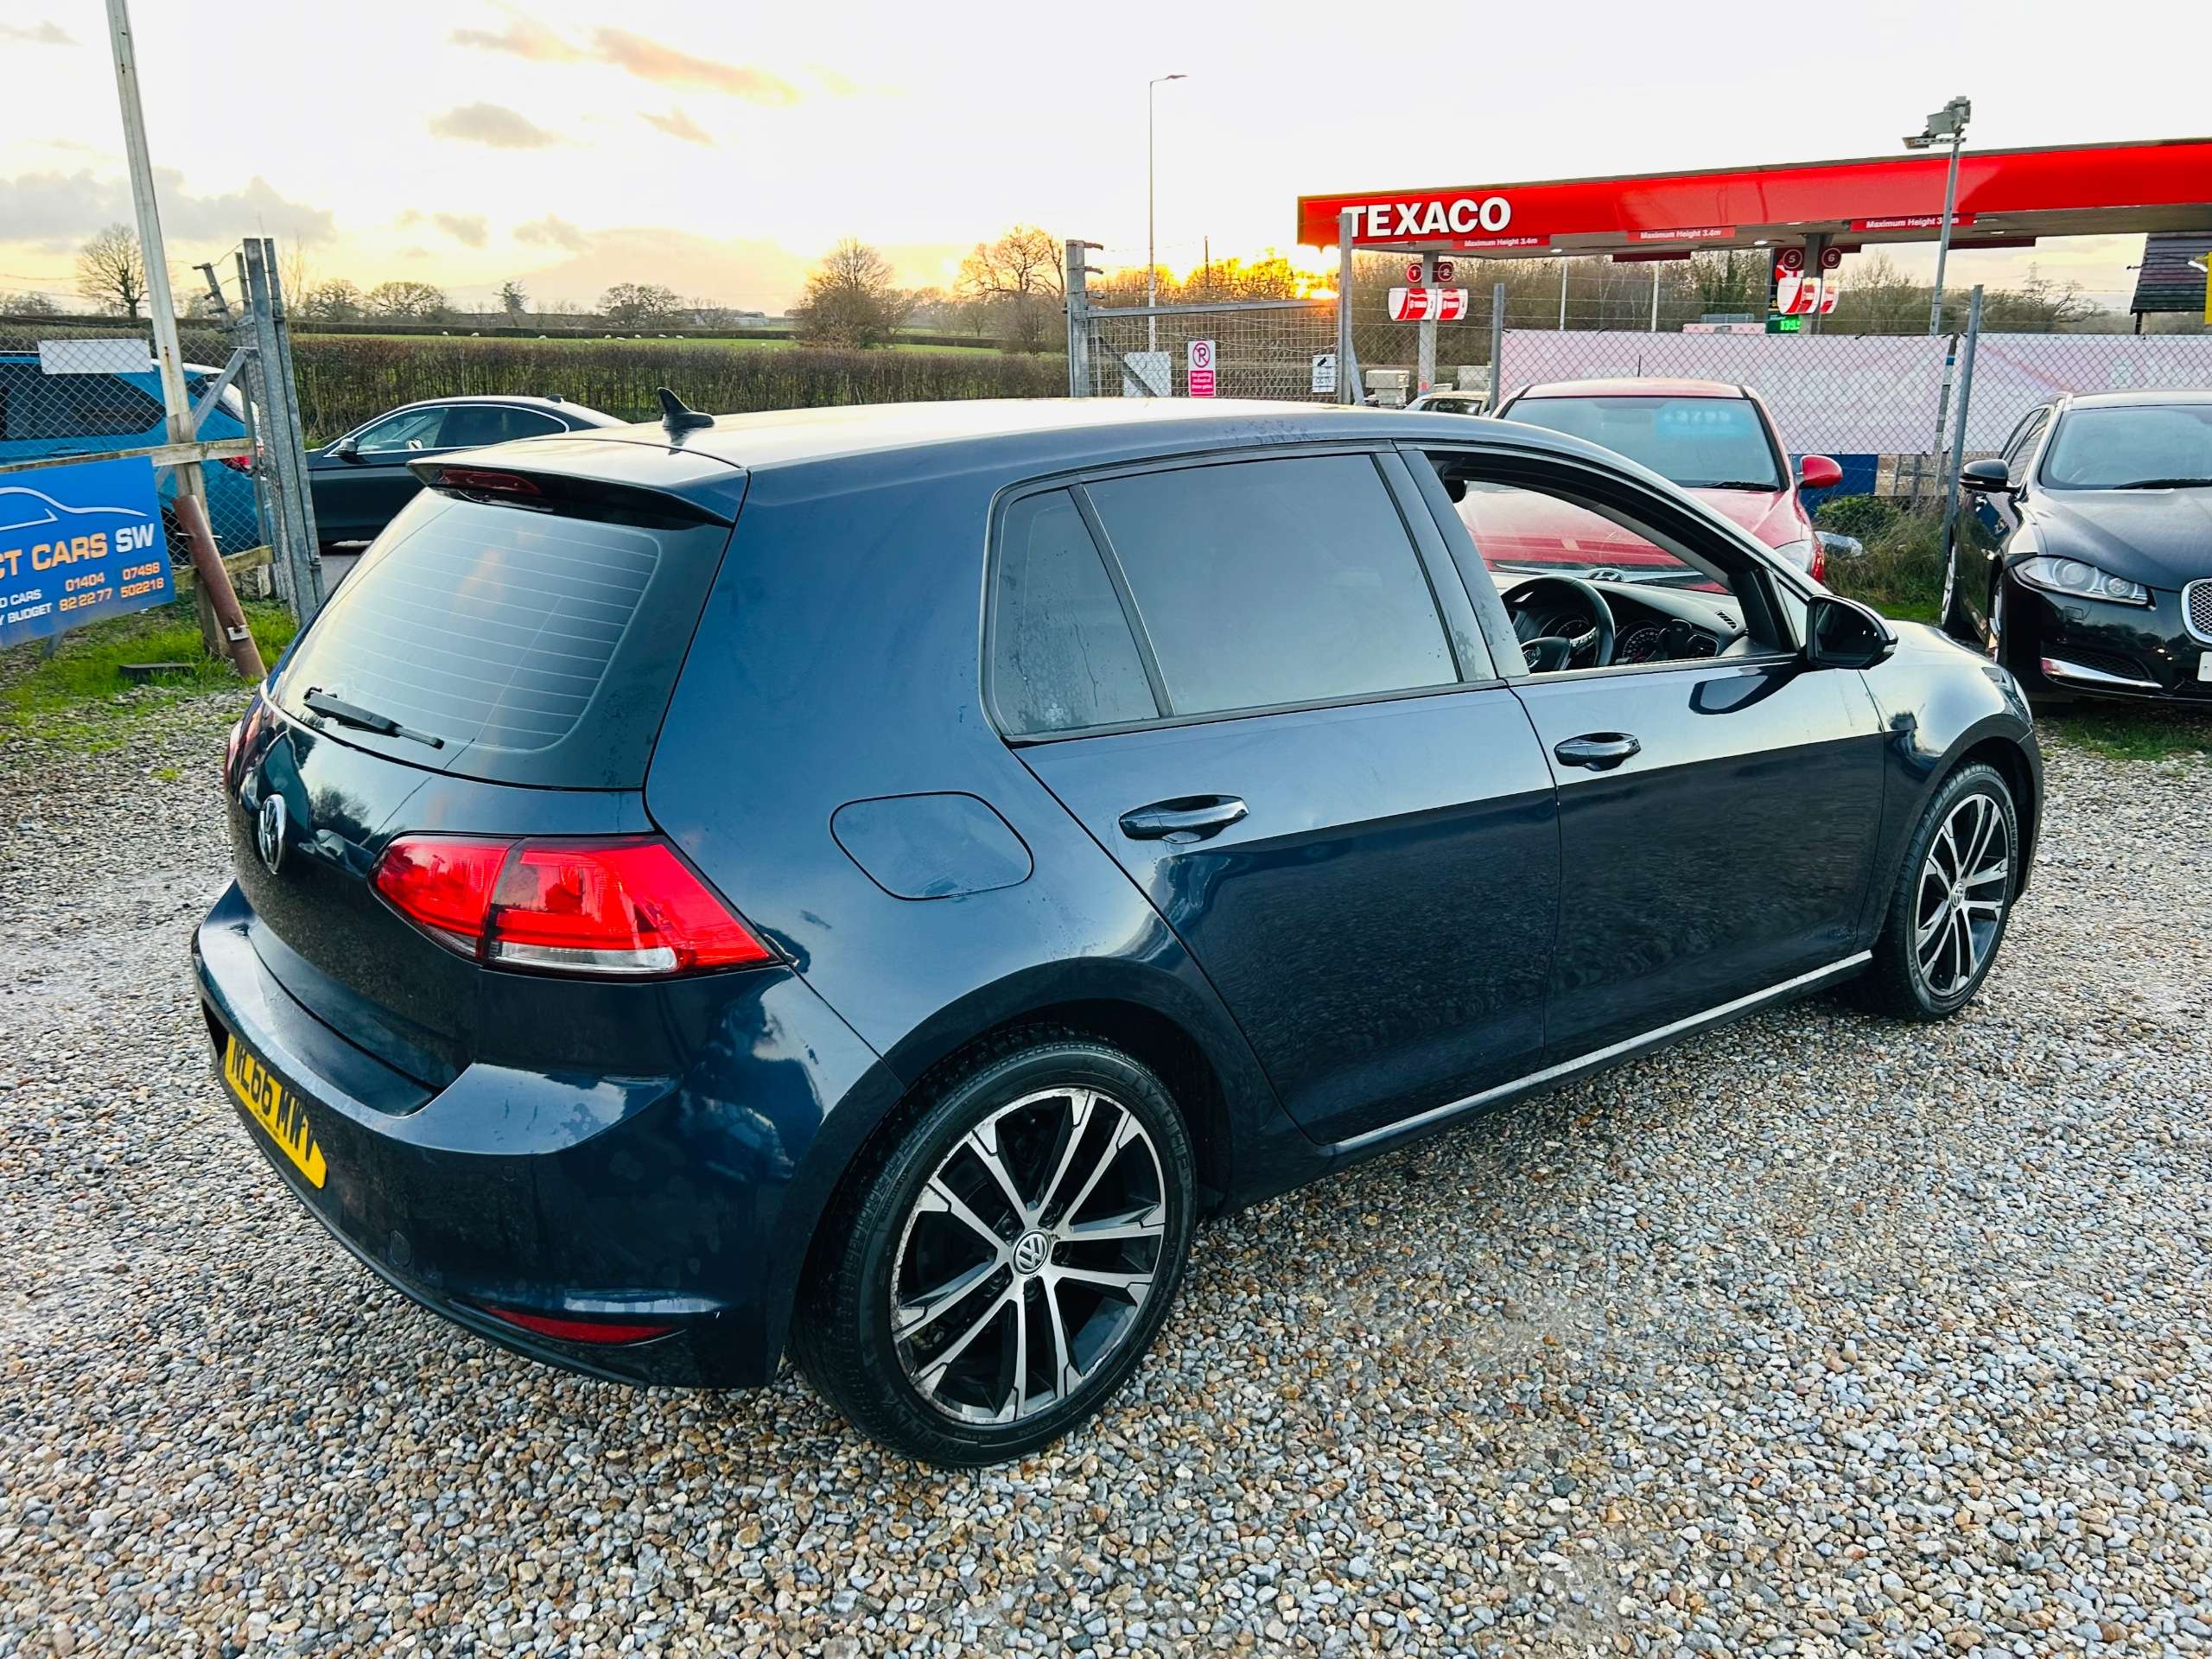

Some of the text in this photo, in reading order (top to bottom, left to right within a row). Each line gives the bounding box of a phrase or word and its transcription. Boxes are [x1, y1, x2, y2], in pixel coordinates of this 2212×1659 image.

[1341, 197, 1511, 238] TEXACO
[1866, 219, 1906, 228] Maximum
[1908, 217, 1936, 226] Height
[1676, 229, 1700, 238] Height
[31, 532, 108, 570] CARS
[115, 523, 155, 553] SW
[65, 572, 105, 592] 01404
[10, 588, 42, 605] CARS
[7, 602, 53, 624] BUDGET
